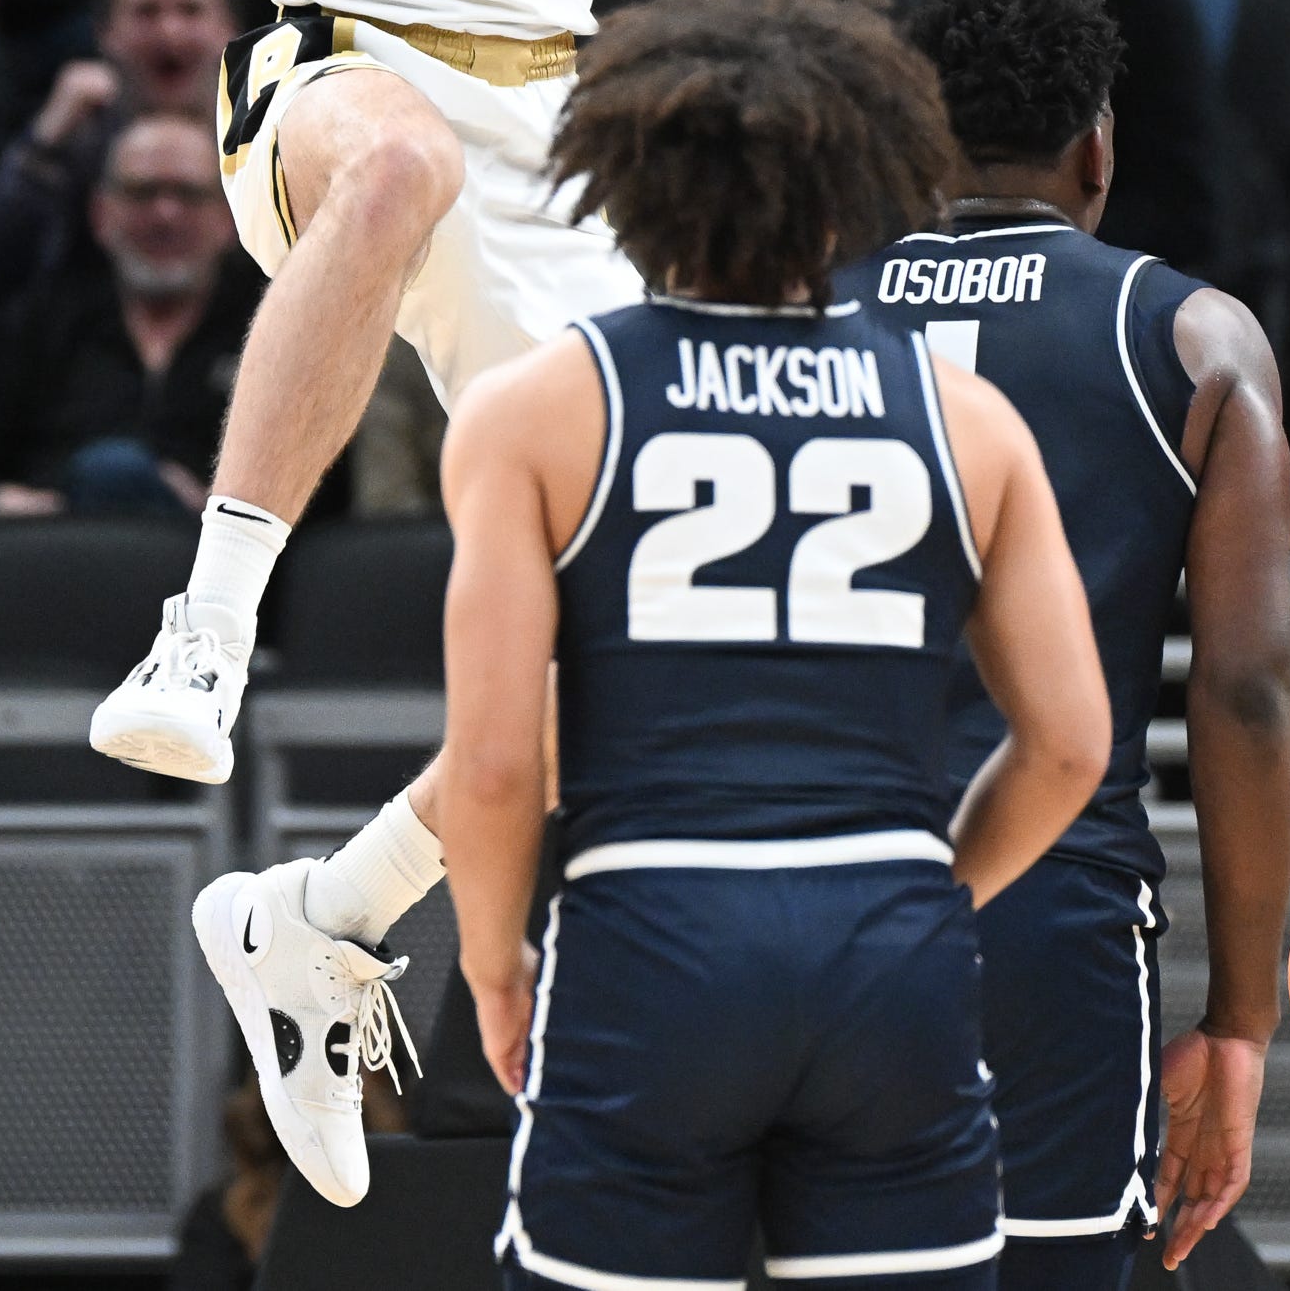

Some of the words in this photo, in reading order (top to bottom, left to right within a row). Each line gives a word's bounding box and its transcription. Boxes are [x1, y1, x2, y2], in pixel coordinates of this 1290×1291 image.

[877, 253, 1047, 304] OSOBOR
[666, 337, 886, 418] JACKSON
[627, 432, 933, 649] 22
